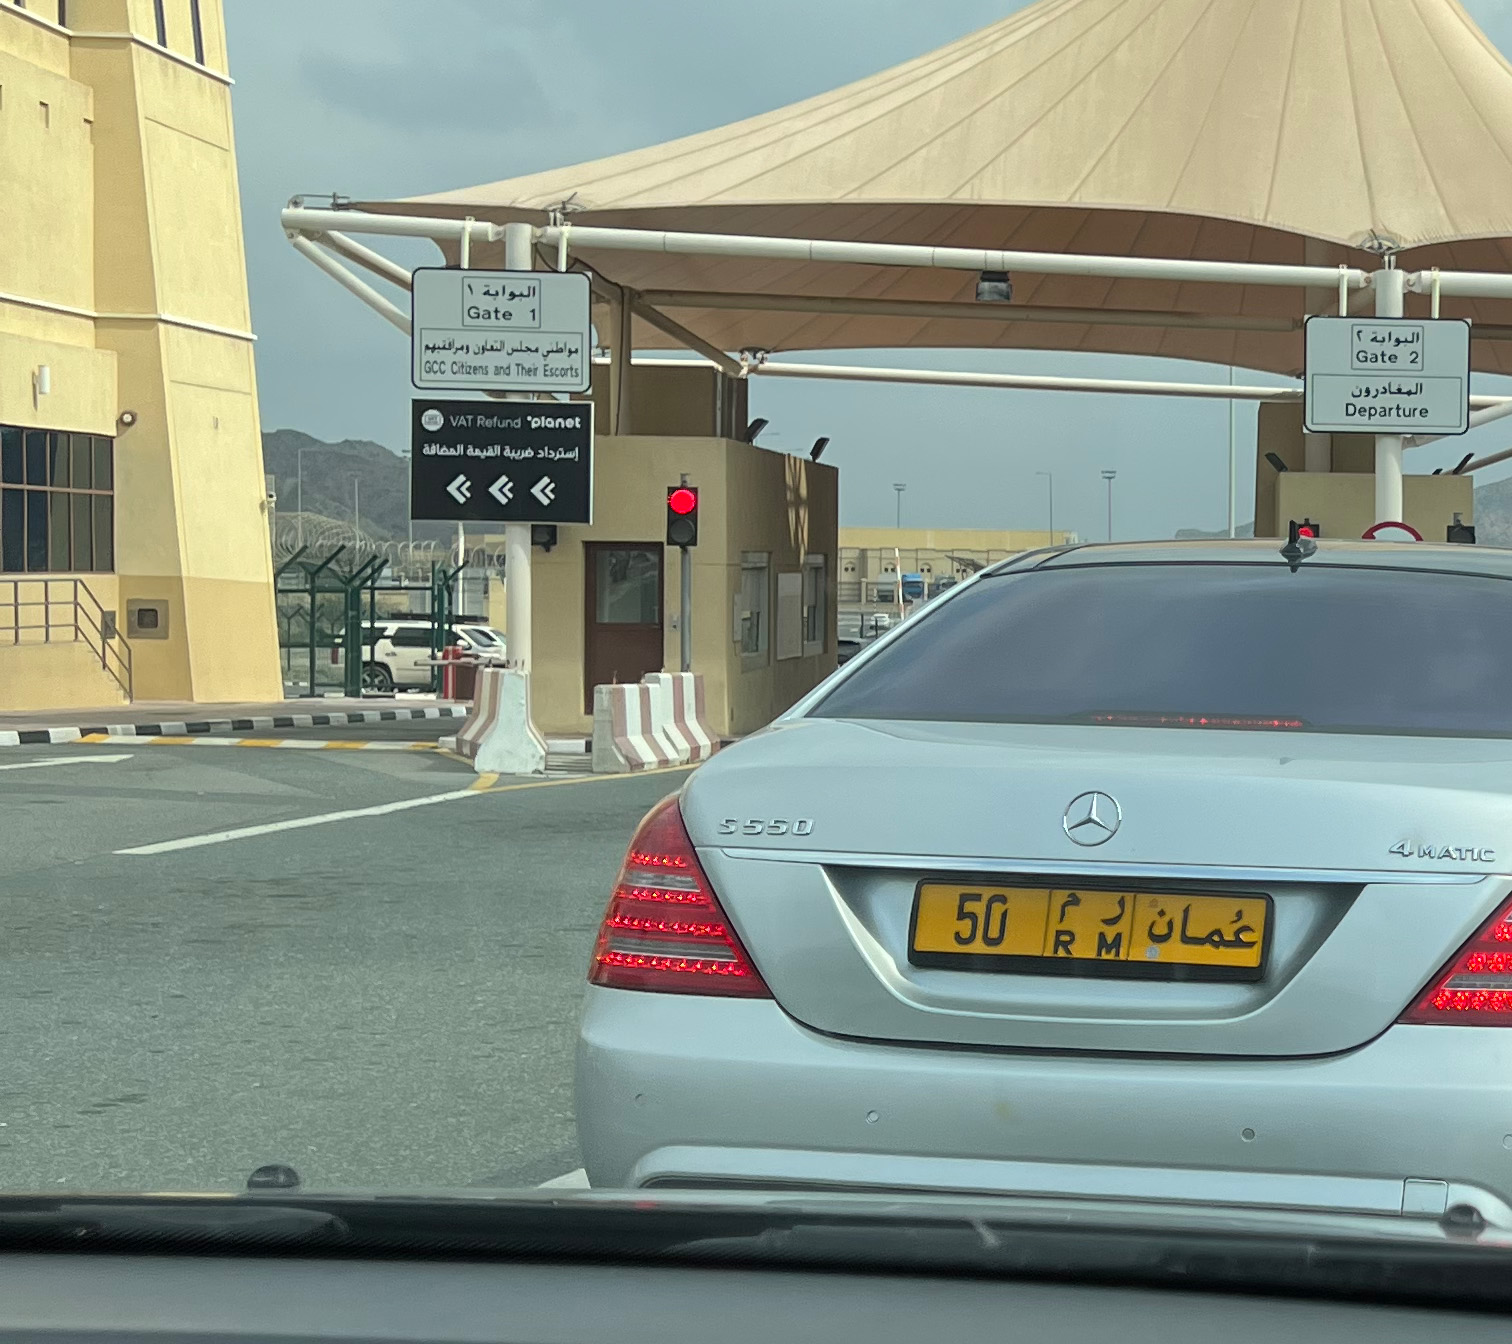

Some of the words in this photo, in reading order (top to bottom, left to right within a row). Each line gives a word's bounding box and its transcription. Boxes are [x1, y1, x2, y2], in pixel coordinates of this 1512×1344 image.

[482, 284, 536, 302] البوابة
[467, 305, 513, 321] Gate
[529, 308, 537, 322] 1
[472, 338, 505, 356] التعاون
[1370, 331, 1420, 347] البوابة
[506, 340, 539, 356] مجلس
[542, 340, 579, 360] مواطني
[1356, 349, 1399, 364] Gate
[1409, 350, 1419, 364] 2
[424, 360, 447, 375] GCC
[450, 361, 489, 376] Citizens
[494, 362, 511, 376] and
[515, 362, 538, 377] Their
[543, 363, 579, 379] Escorts
[1351, 381, 1423, 399] المغادرون
[1345, 402, 1429, 421] Departure
[450, 415, 474, 428] VAT
[477, 415, 522, 429] Refund
[422, 442, 464, 457] المضافة
[466, 444, 500, 460] القيمة
[503, 445, 535, 461] ضريبة
[953, 892, 1009, 948] 50
[1053, 929, 1077, 957] R
[1096, 931, 1122, 959] M
